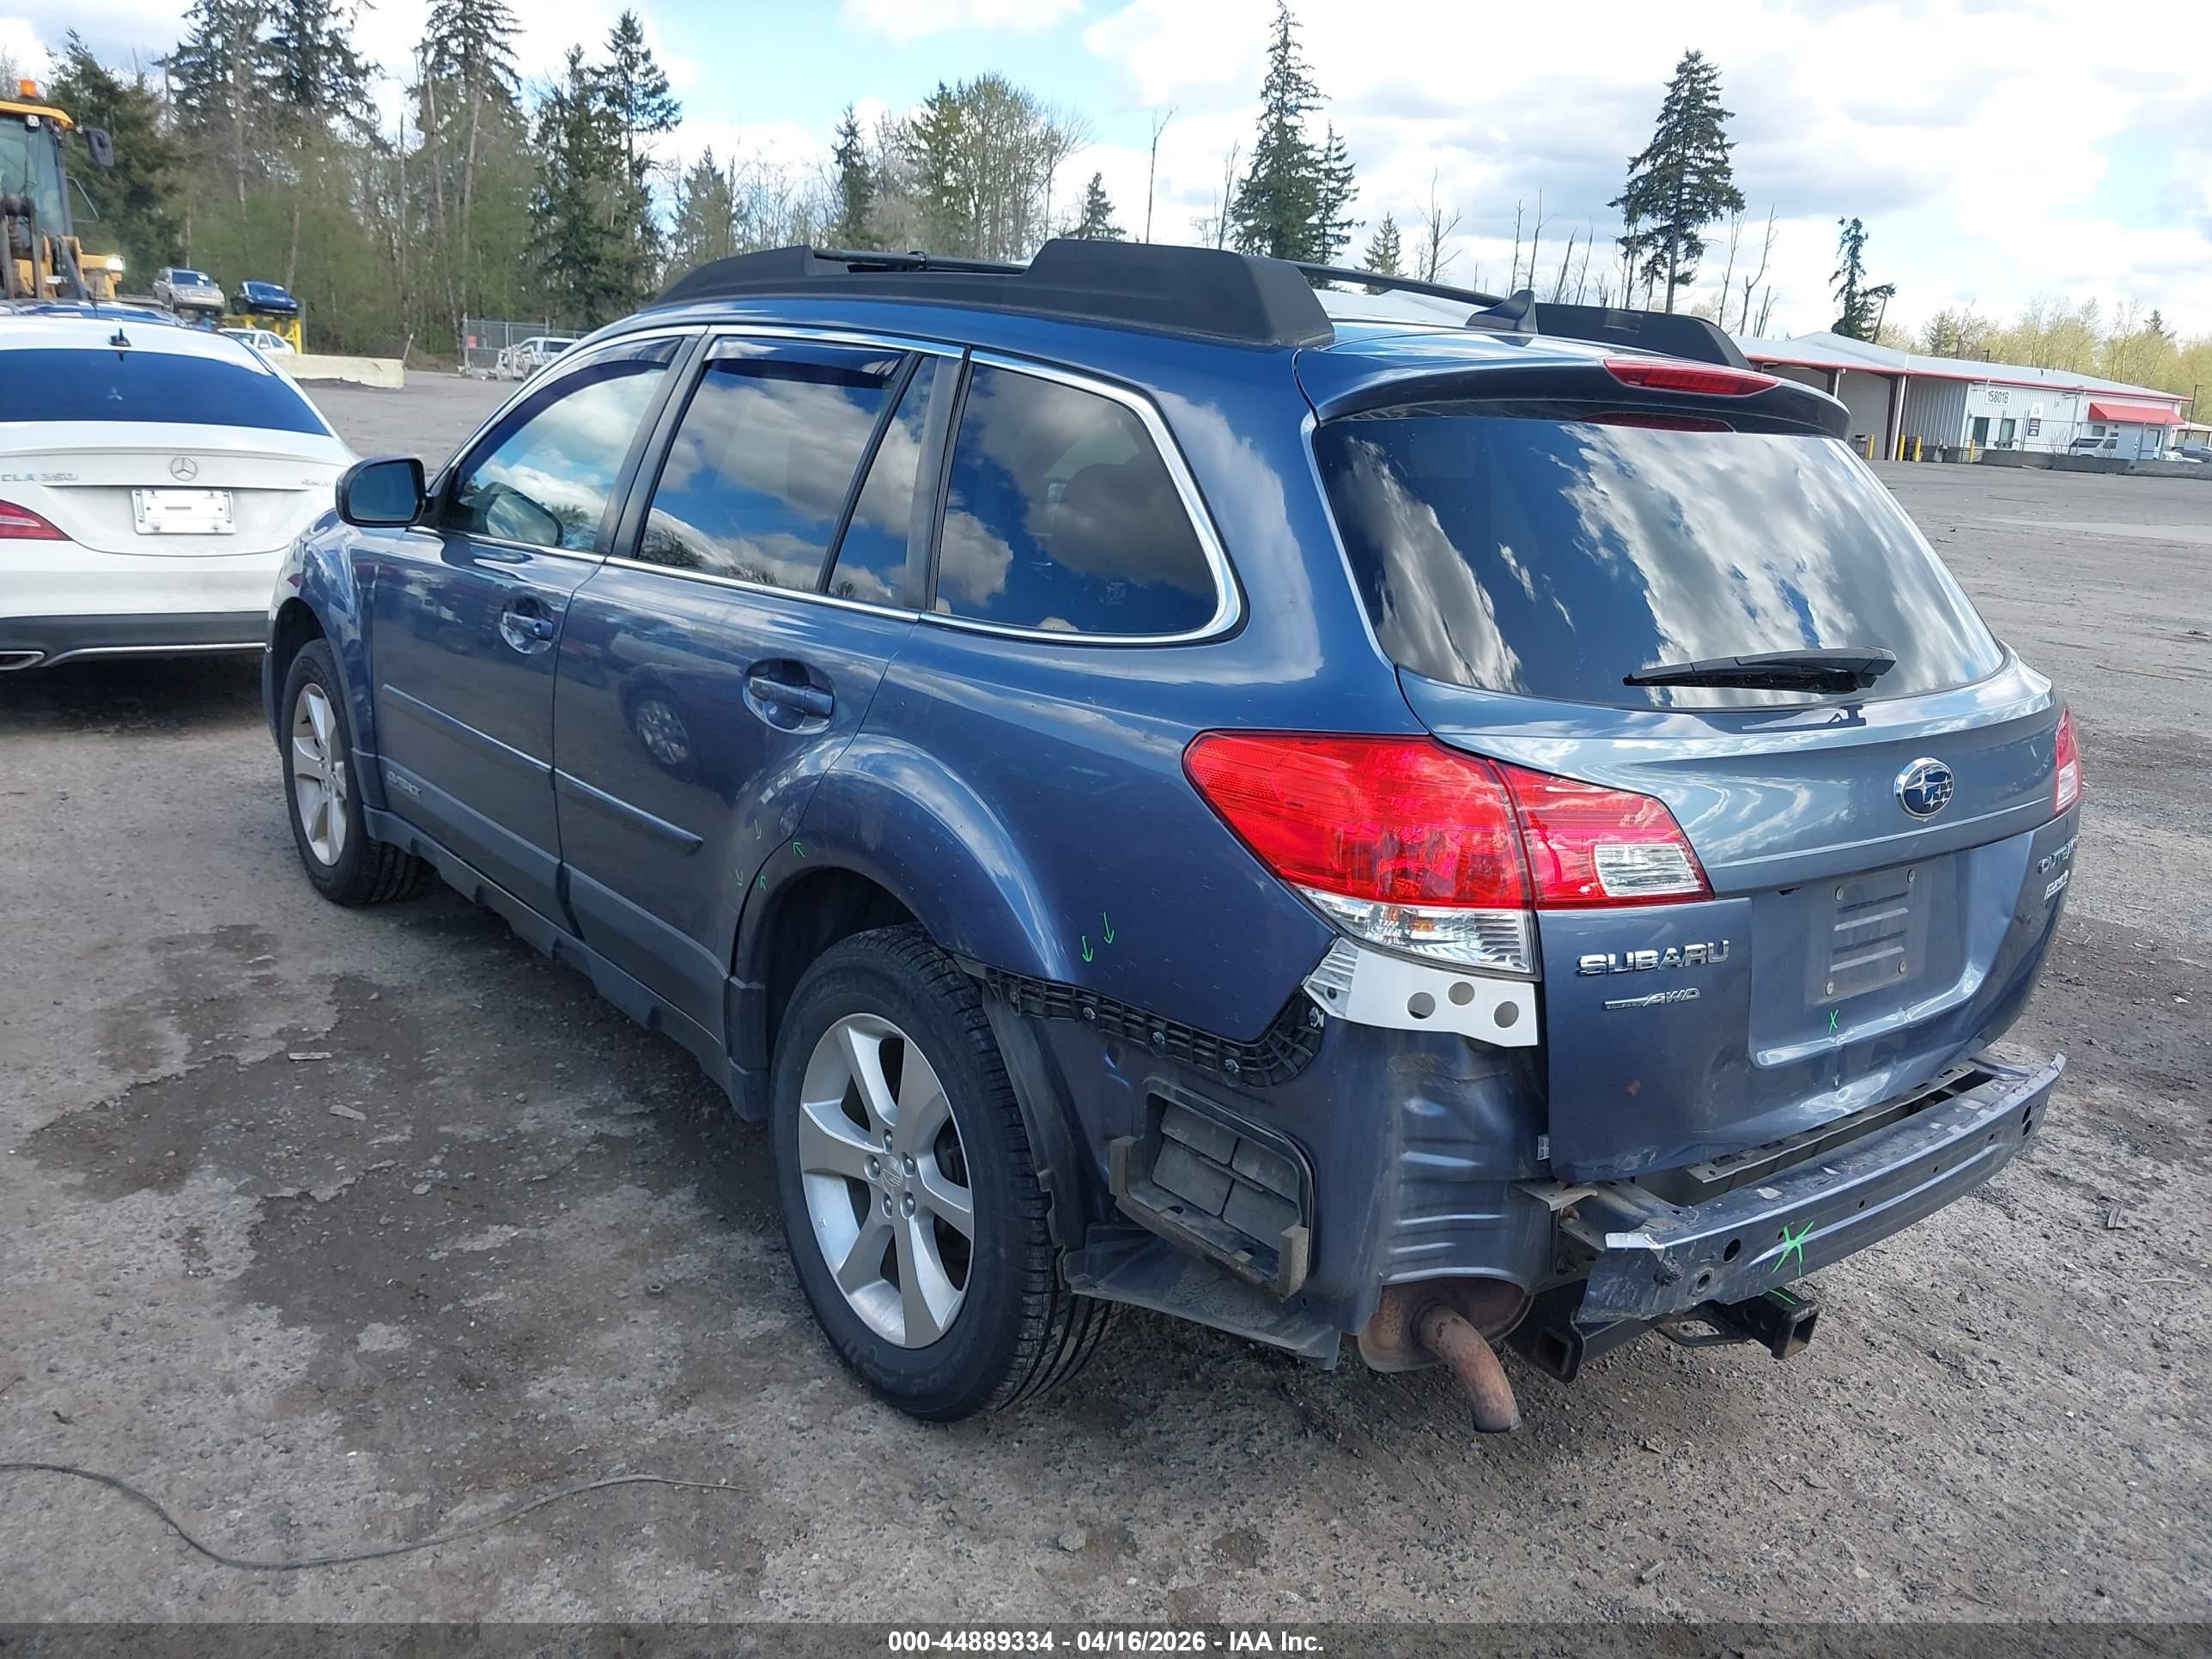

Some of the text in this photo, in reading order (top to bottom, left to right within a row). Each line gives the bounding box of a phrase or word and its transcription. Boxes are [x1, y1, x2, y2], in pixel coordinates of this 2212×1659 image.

[2, 473, 36, 483] CLA
[1575, 939, 1730, 977] SUBARU
[1642, 988, 1701, 1008] AWD
